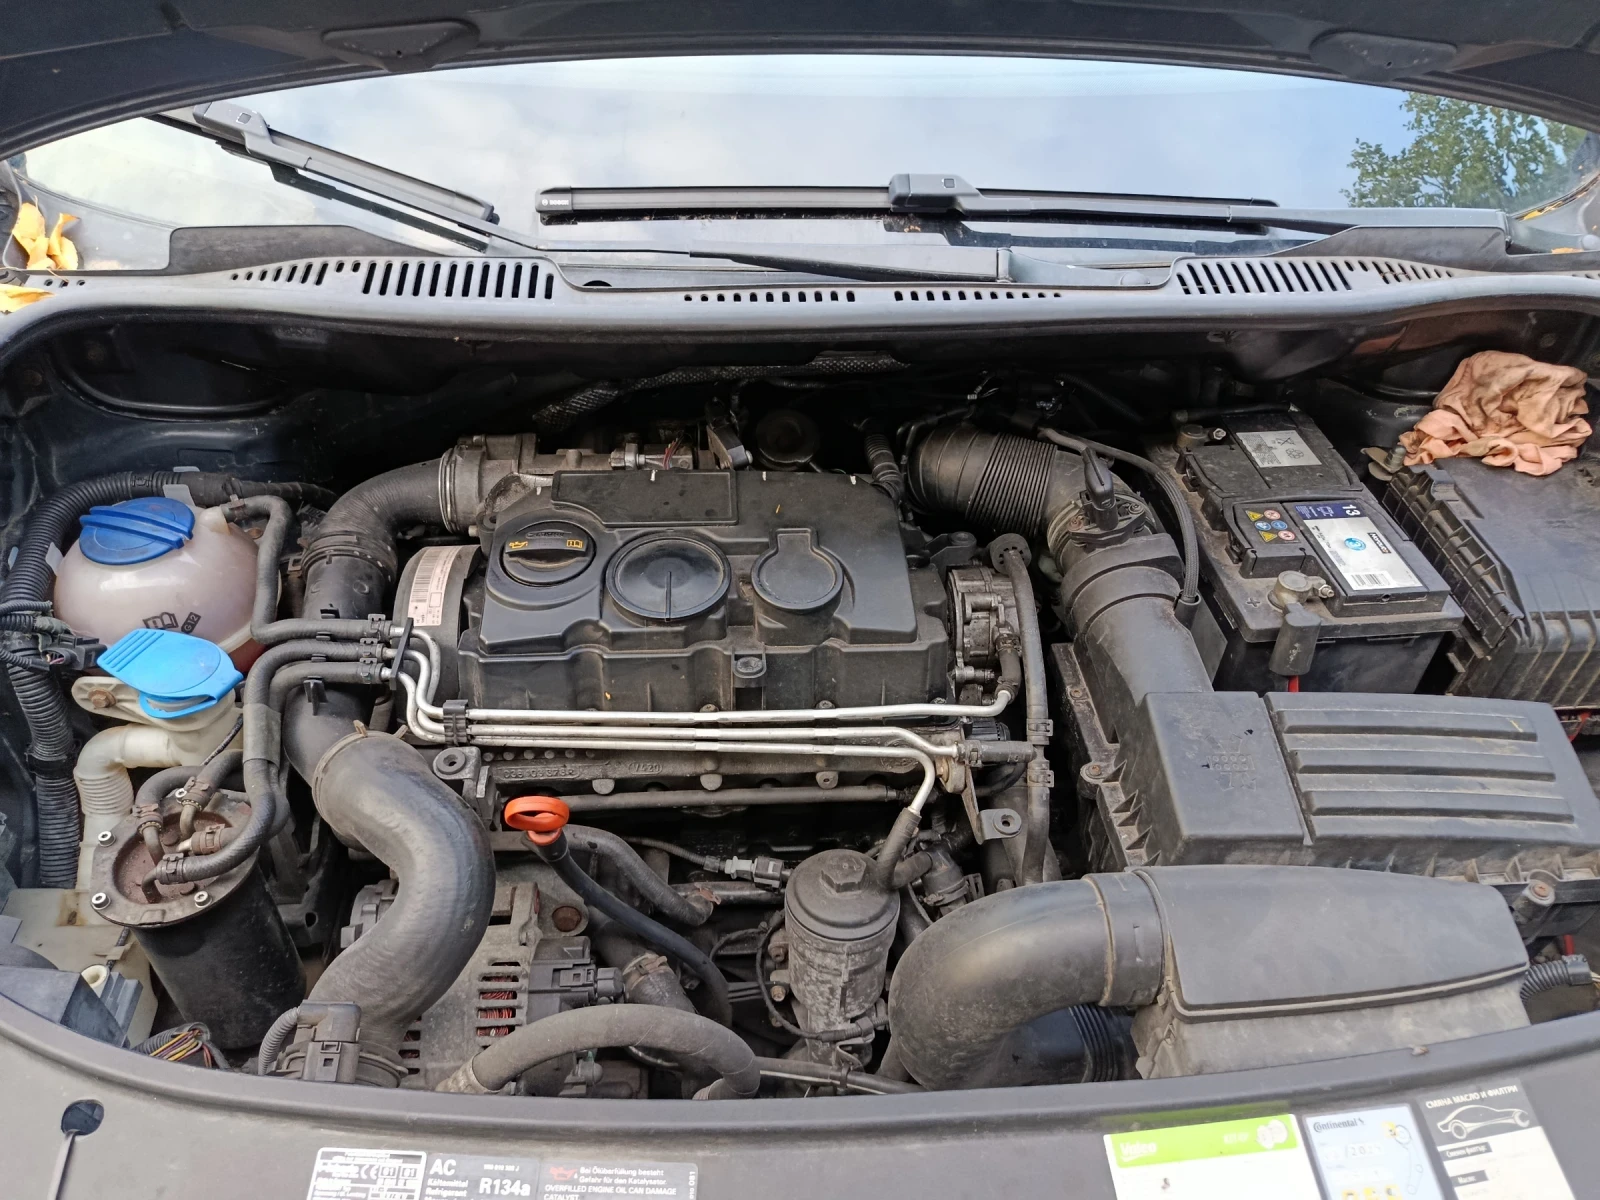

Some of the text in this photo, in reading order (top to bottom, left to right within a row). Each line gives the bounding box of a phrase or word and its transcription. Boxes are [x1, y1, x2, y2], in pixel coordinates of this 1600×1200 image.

[1342, 504, 1361, 516] 13
[184, 614, 199, 631] G12
[1425, 1085, 1519, 1109] СМЯНА МАСЛО И ФИЛТРИ
[1313, 1118, 1358, 1133] Continental
[429, 1159, 457, 1176] AC
[580, 1165, 665, 1177] Bei Ölüberfüllung besteht
[427, 1177, 469, 1188] Kältemittel
[579, 1175, 602, 1184] Gefahr
[603, 1176, 613, 1184] für
[613, 1177, 627, 1185] den
[425, 1187, 468, 1198] Refrigerant
[479, 1177, 531, 1196] R134a
[545, 1184, 677, 1196] OVERFILLED ENGINE OIL CAN DAMAGE
